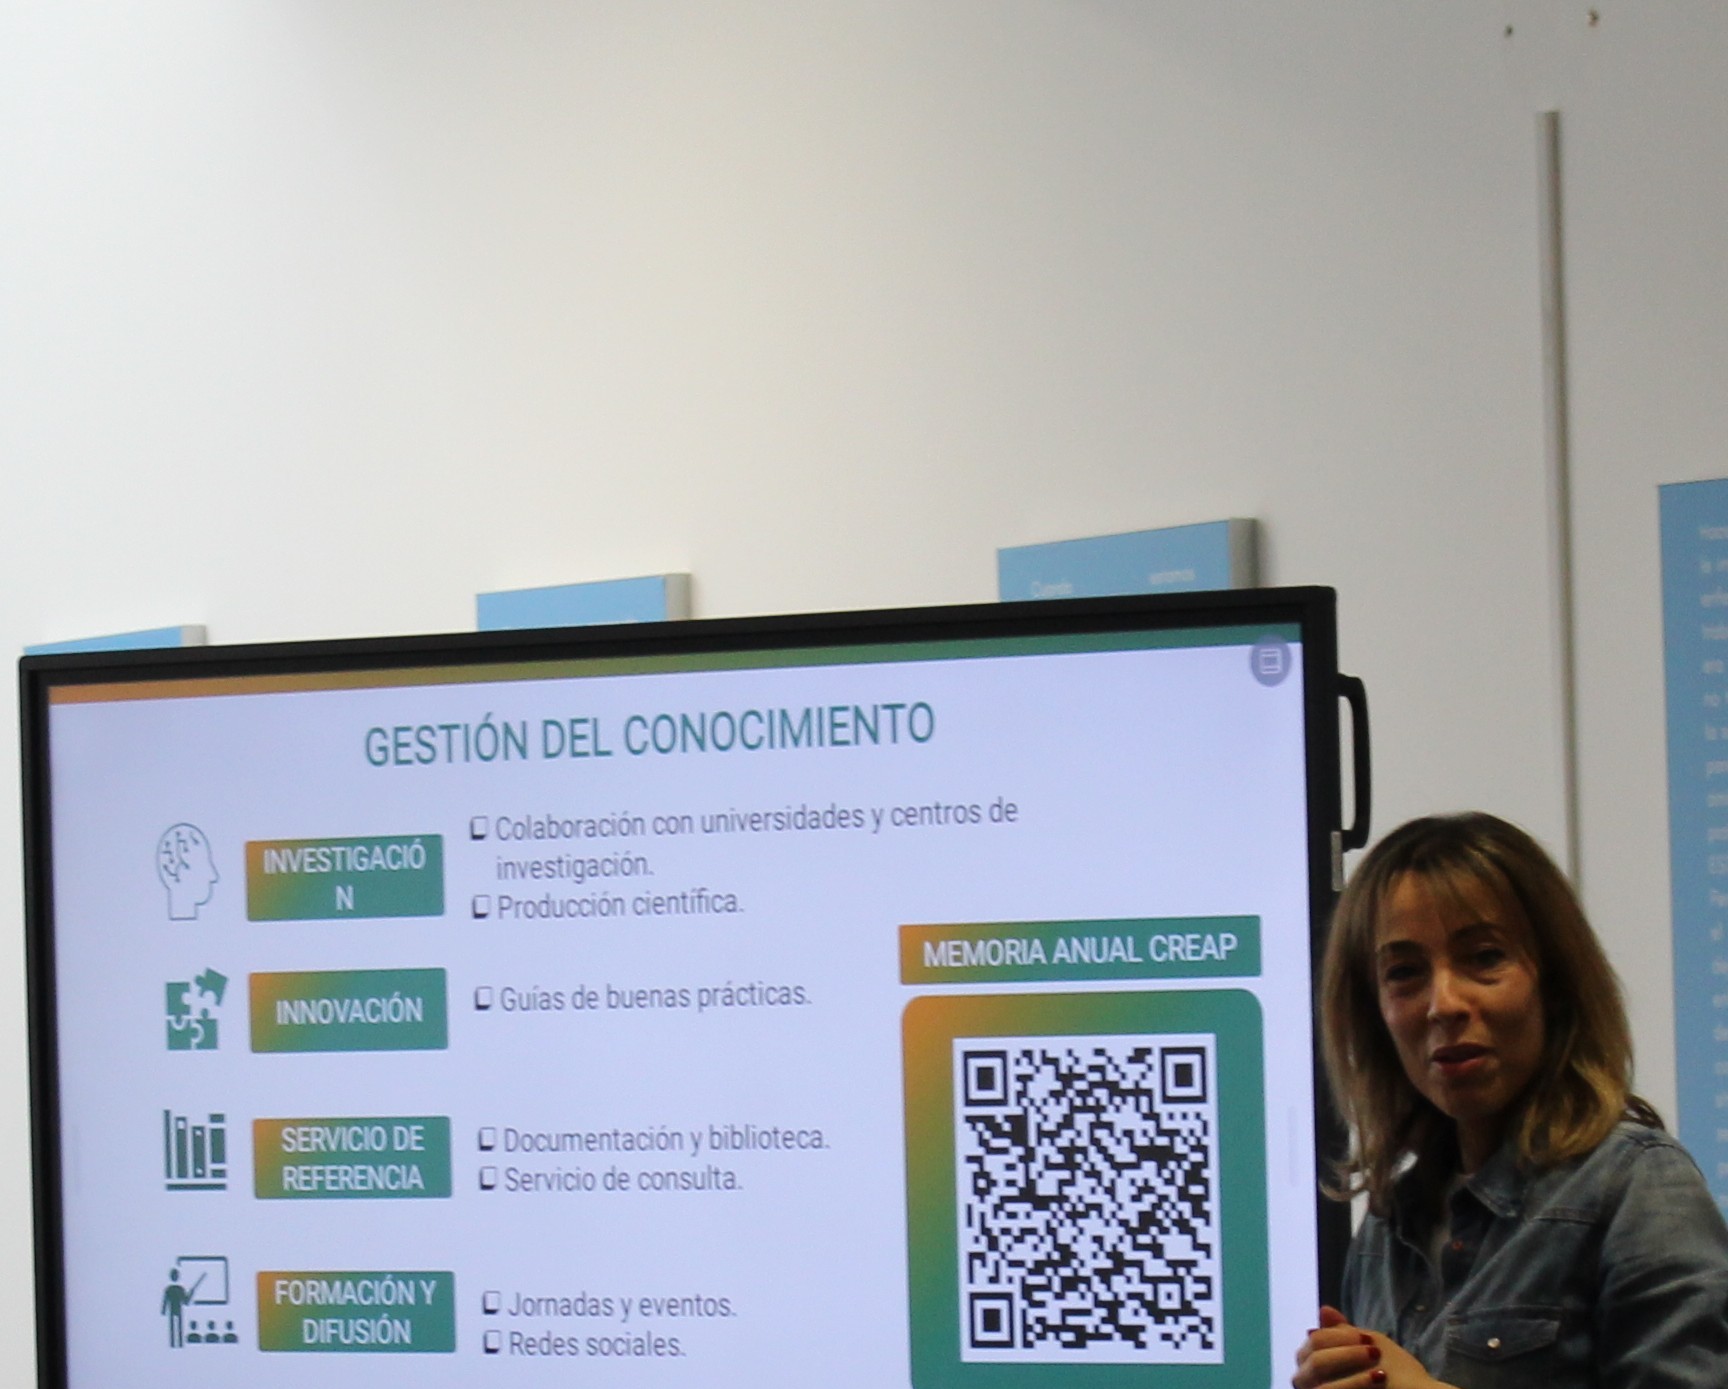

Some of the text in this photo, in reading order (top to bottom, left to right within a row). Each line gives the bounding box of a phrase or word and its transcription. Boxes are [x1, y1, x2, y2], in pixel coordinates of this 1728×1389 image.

[364, 701, 936, 768] GESTIÓN DEL CONOCIMIENTO
[495, 797, 1019, 841] Colaboración con universidades y centros de
[264, 838, 427, 874] INVESTIGACIÓ
[496, 850, 655, 885] investigación.
[335, 884, 355, 911] N
[497, 887, 744, 921] Producción científica.
[924, 933, 1238, 967] MEMORIA ANUAL CREAP
[277, 991, 423, 1024] INNOVACIÓN
[500, 980, 812, 1011] Guías de buenas prácticas.
[282, 1125, 425, 1153] SERVICIO DE
[504, 1124, 830, 1157] Documentación y biblioteca.
[283, 1164, 424, 1192] REFERENCIA
[505, 1165, 743, 1191] Servicio de consulta.
[275, 1274, 437, 1306] FORMACIÓN Y
[507, 1290, 737, 1323] Jornadas y eventos.
[303, 1313, 412, 1345] DIFUSIÓN
[509, 1331, 686, 1356] Redes sociales.
